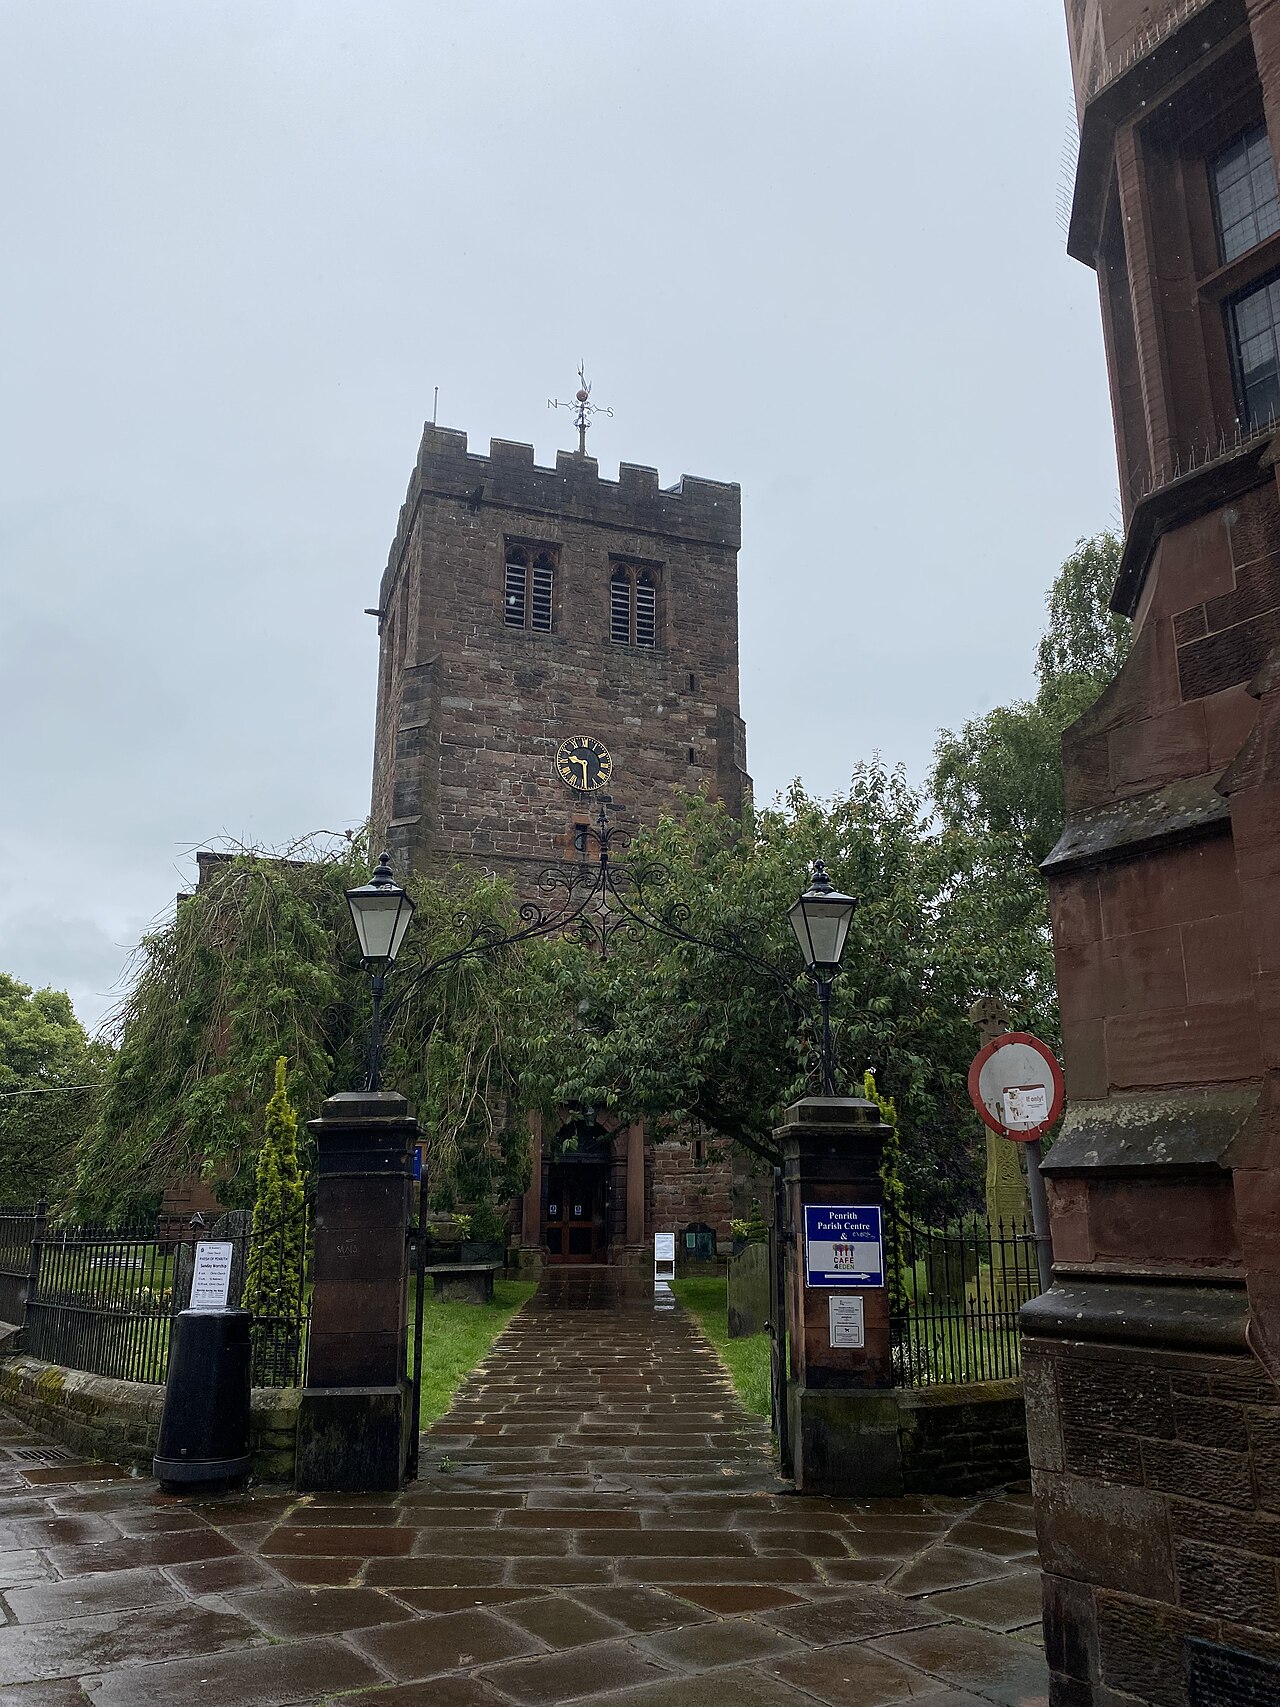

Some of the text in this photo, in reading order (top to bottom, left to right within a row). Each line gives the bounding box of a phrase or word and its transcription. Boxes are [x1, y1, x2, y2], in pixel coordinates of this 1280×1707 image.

[547, 399, 558, 408] N
[606, 406, 614, 417] S
[829, 1212, 858, 1220] Penrith
[817, 1222, 871, 1230] Parish Centre
[840, 1232, 848, 1240] &
